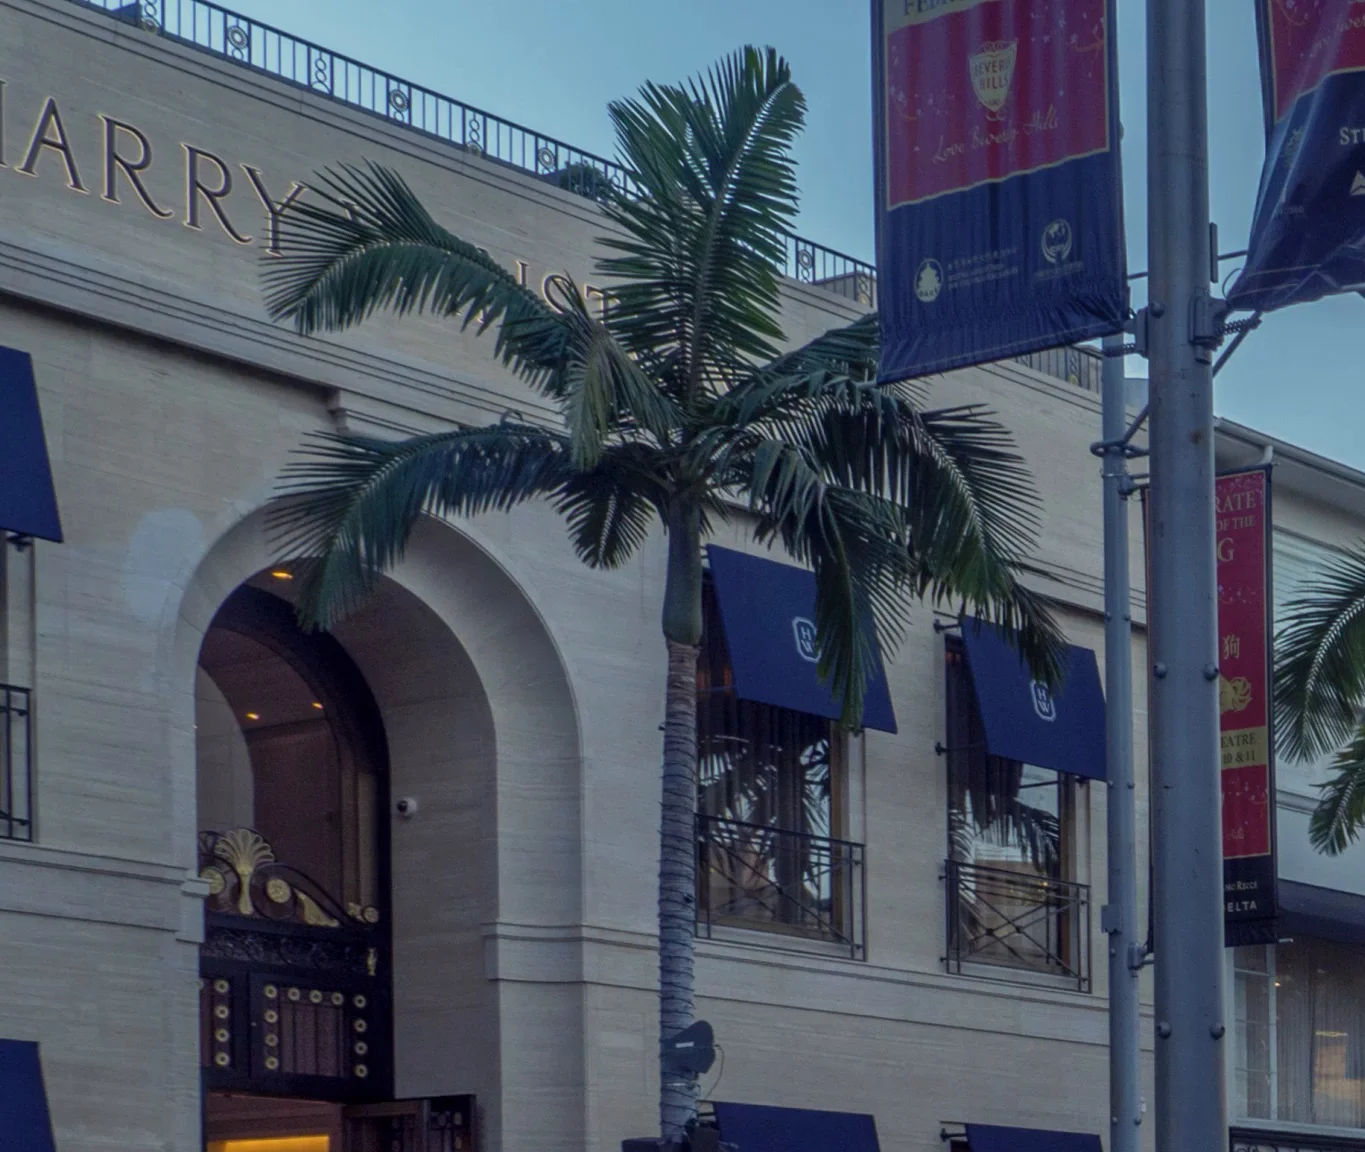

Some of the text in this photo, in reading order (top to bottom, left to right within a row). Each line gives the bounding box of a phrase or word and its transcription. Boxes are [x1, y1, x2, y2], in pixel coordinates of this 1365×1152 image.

[0, 80, 309, 257] ARRY
[1232, 515, 1256, 530] THE
[1226, 900, 1257, 913] ELTA
